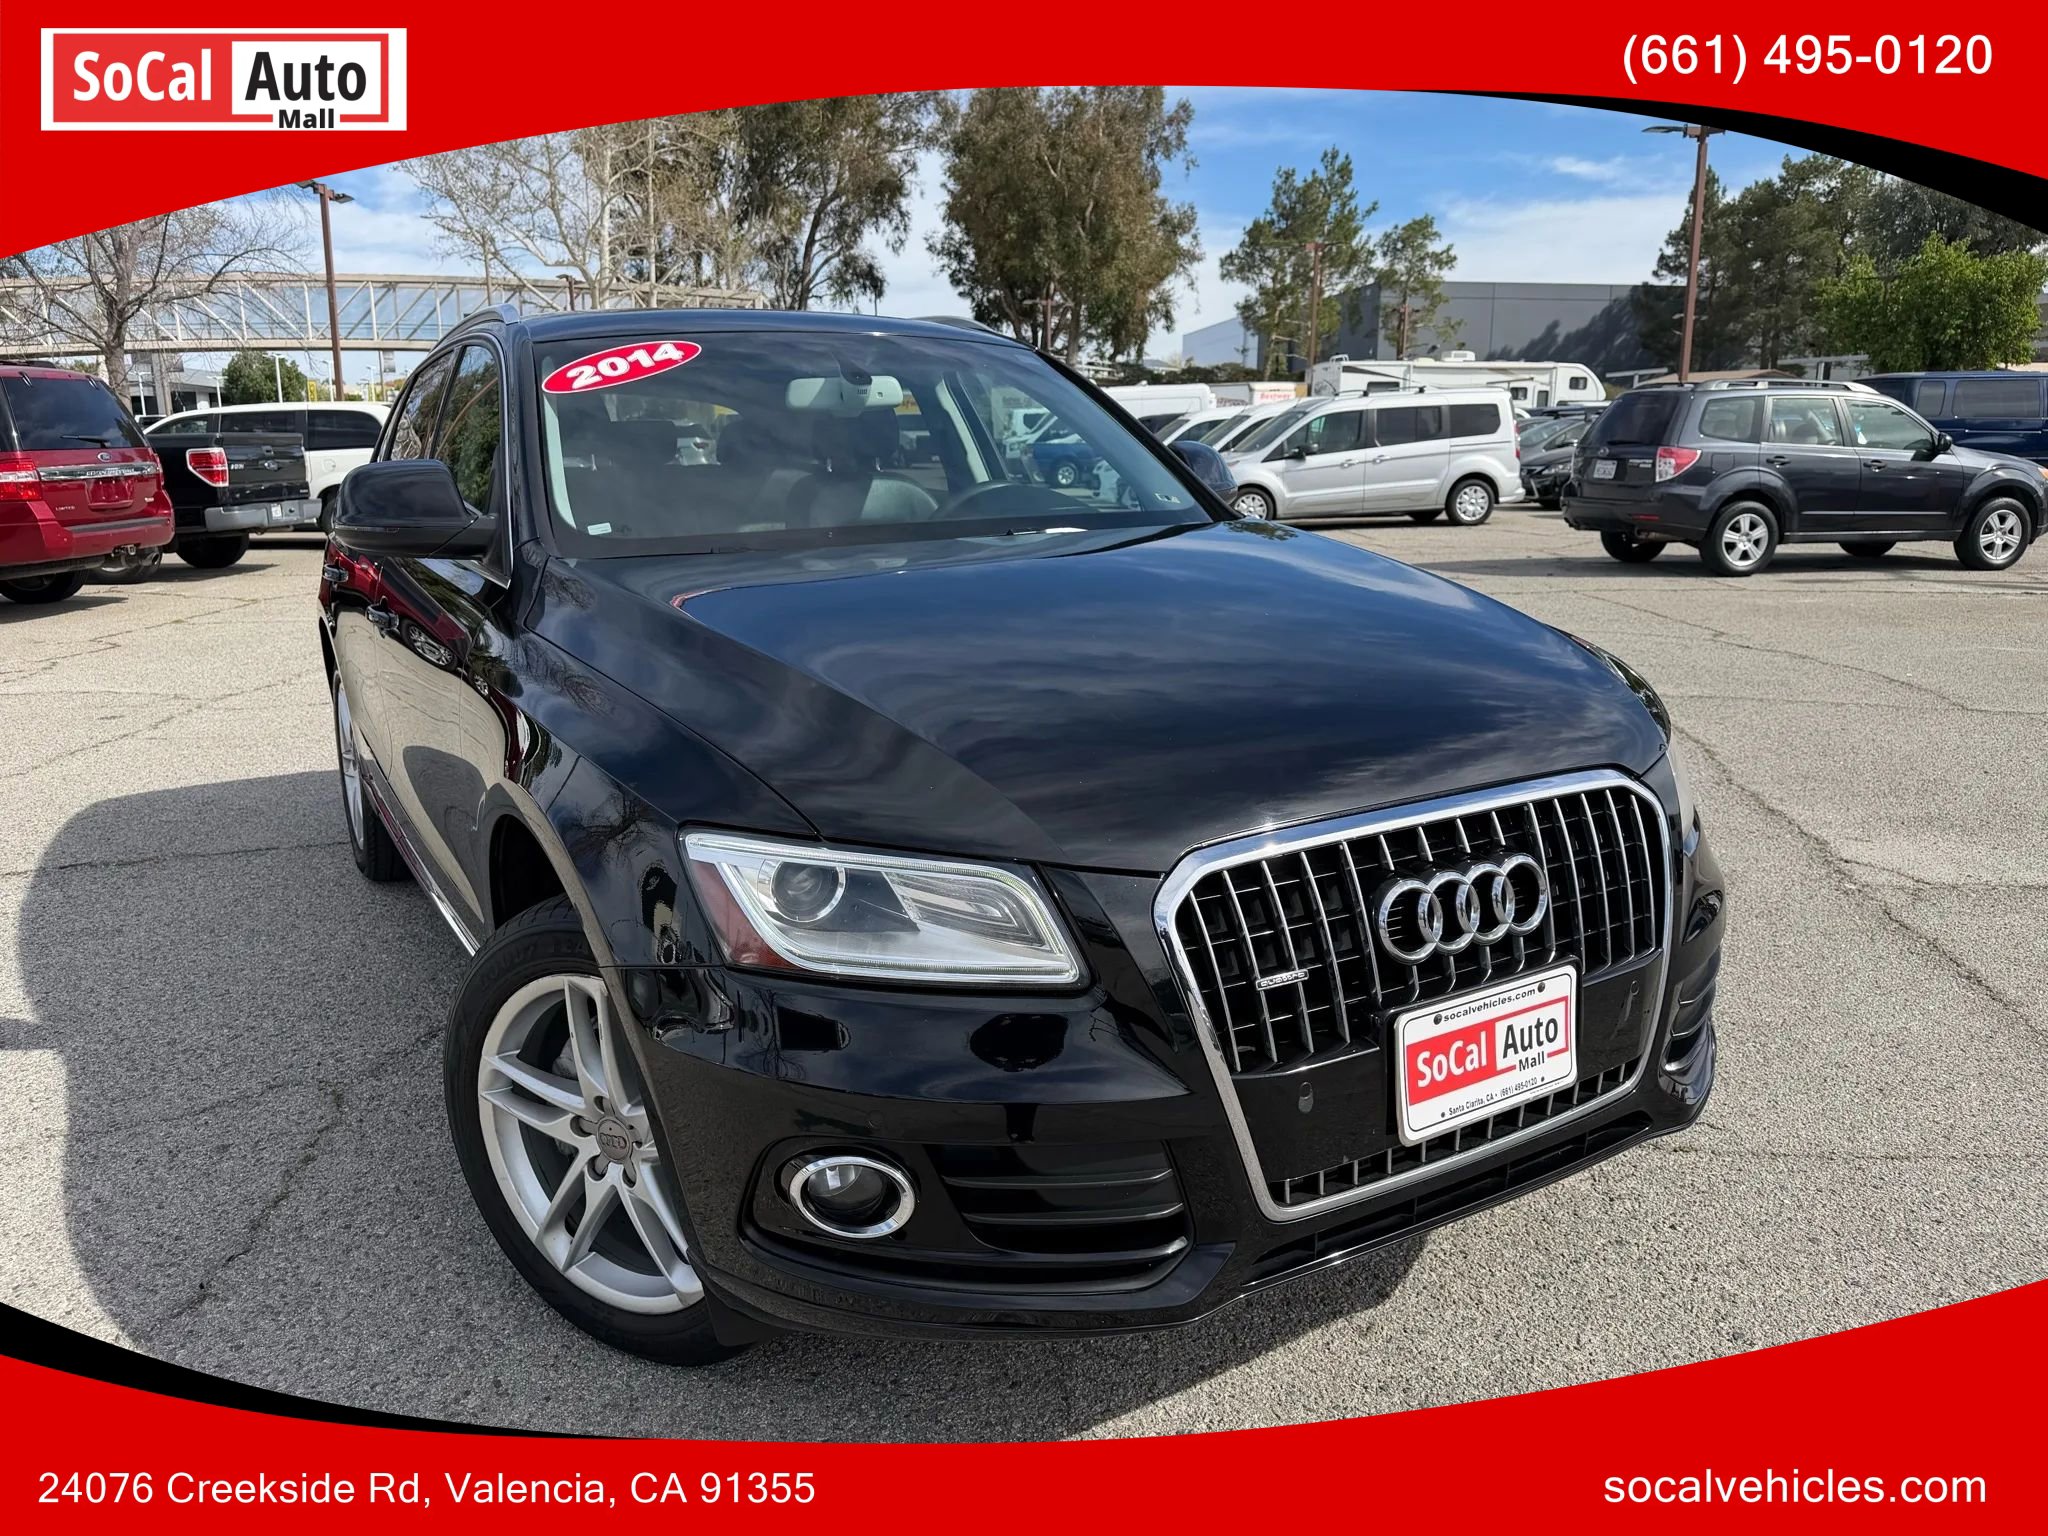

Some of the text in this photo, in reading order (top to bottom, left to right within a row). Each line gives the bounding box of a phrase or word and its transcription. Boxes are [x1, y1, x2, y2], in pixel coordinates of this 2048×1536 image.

[566, 342, 685, 390] 2014
[1443, 988, 1537, 1022] socalvehicles.com
[1417, 1017, 1559, 1089] SoCal Auto
[1519, 1051, 1546, 1072] Mall
[1448, 1104, 1465, 1116] Santa
[1486, 1092, 1495, 1102] CA
